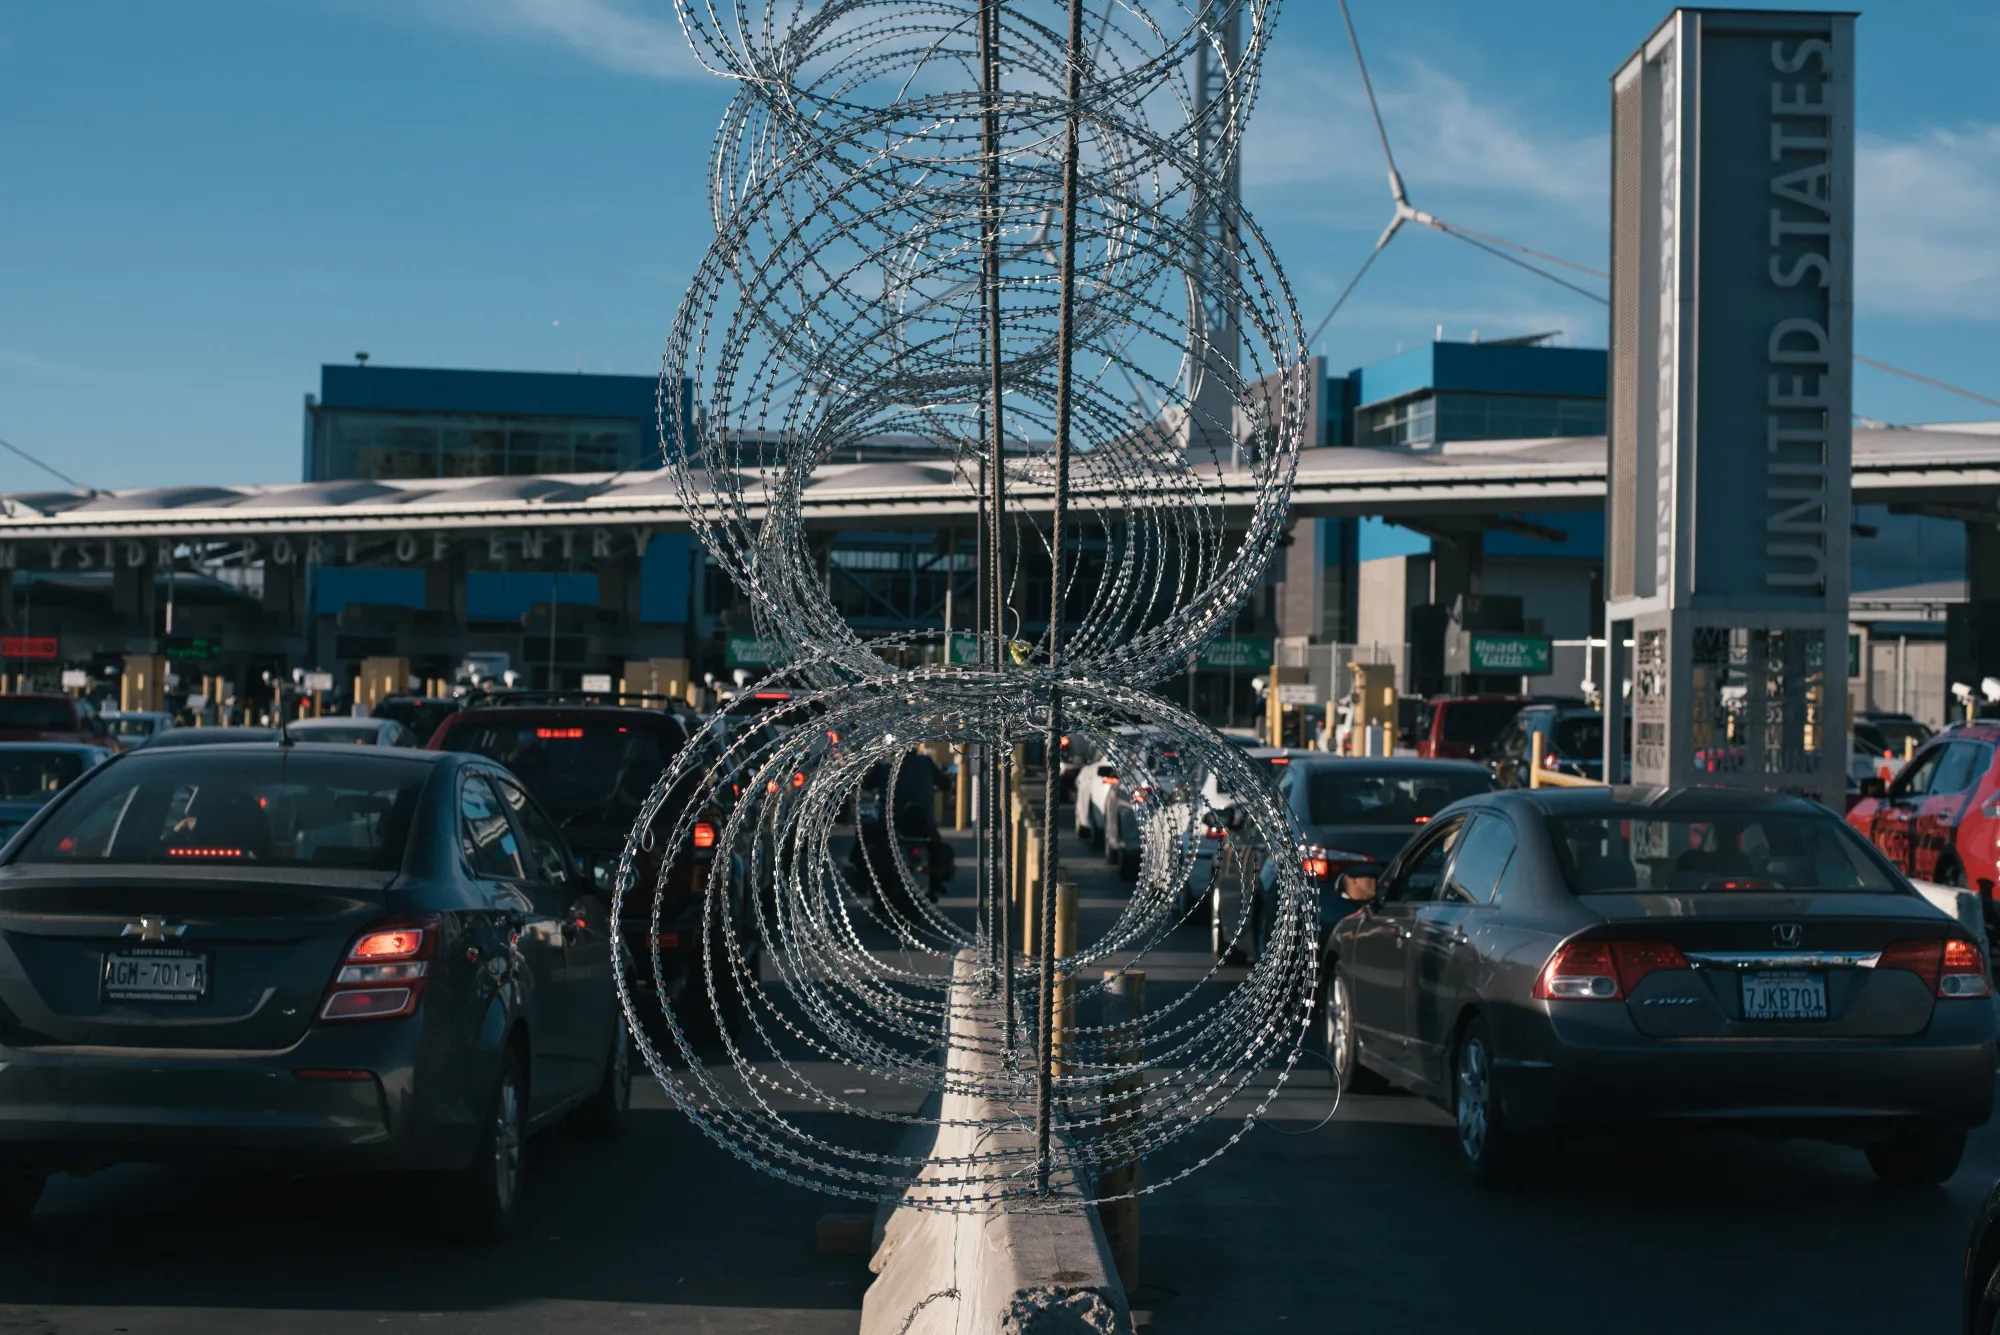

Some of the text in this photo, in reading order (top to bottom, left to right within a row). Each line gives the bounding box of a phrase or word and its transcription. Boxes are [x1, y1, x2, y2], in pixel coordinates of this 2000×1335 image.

[1766, 38, 1831, 586] UNITED STATES
[49, 539, 205, 569] YSIDRO
[243, 534, 357, 566] PORT
[396, 531, 450, 562] OF
[488, 528, 651, 560] ENTRY
[1475, 640, 1529, 654] Ready
[108, 961, 204, 987] AGM-701-A
[1745, 987, 1824, 1010] 7JKB701
